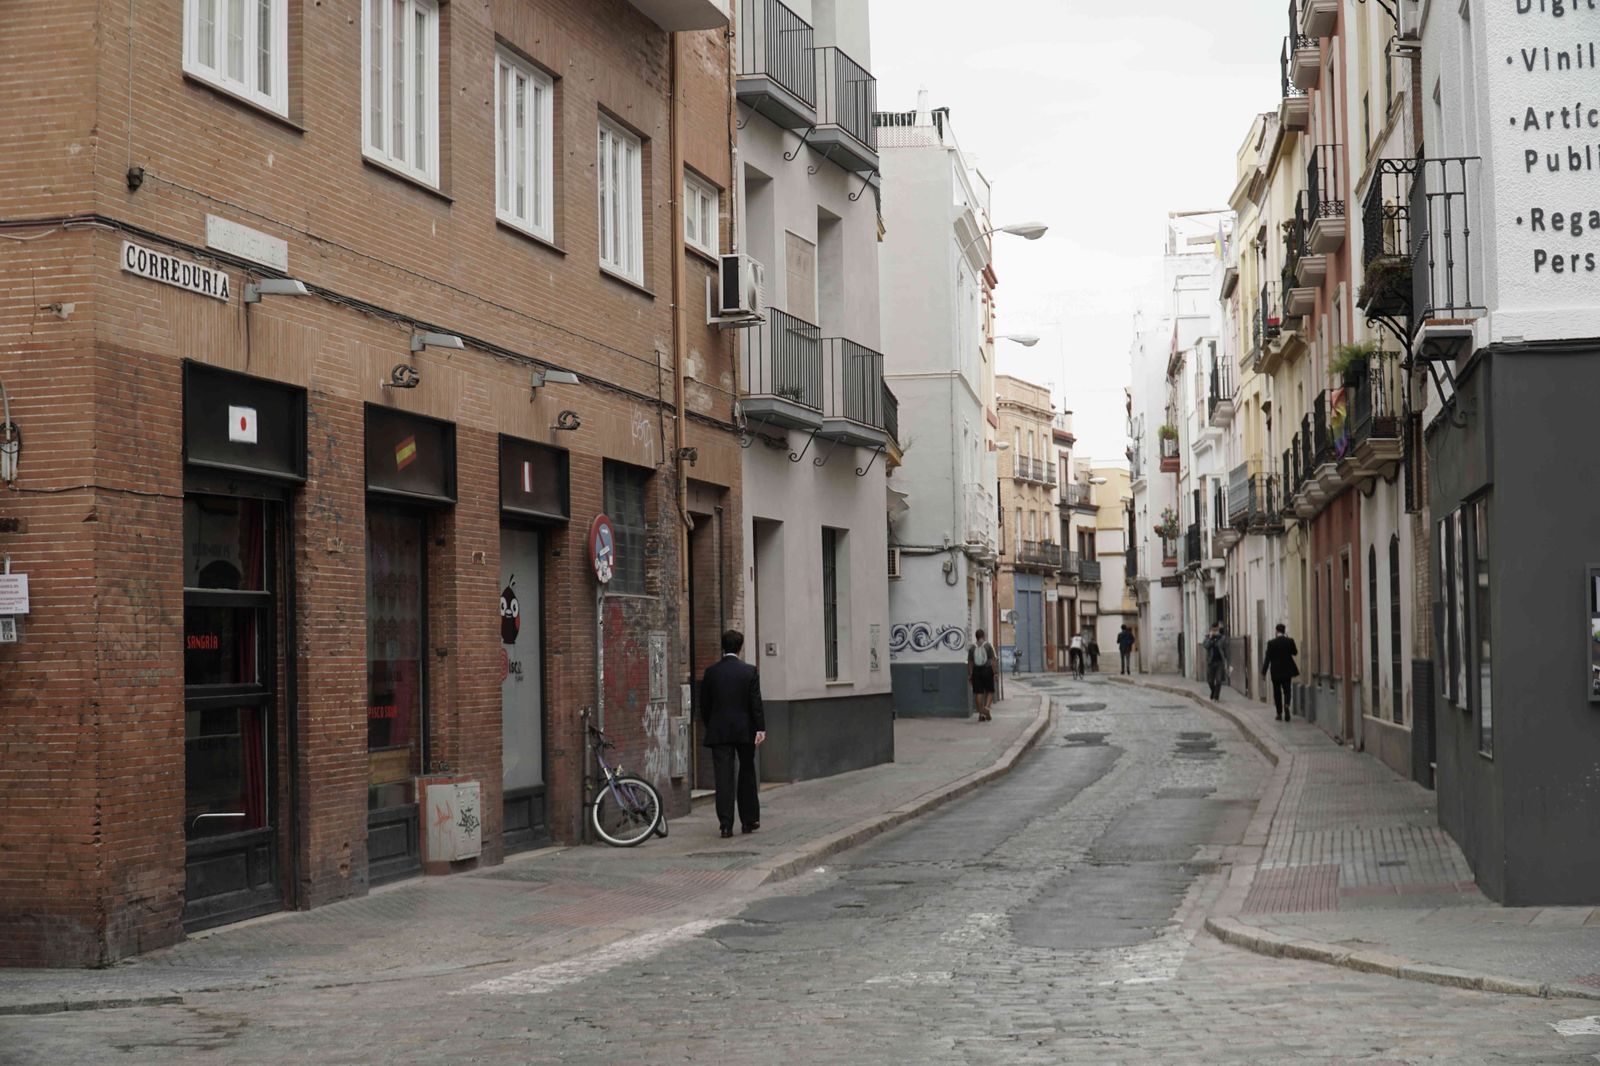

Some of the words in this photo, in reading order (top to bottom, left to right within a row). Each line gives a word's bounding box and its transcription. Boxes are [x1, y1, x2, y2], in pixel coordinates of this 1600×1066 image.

[1521, 42, 1595, 72] Vinil
[1523, 102, 1599, 131] Artíc
[1531, 207, 1600, 237] Rega
[126, 245, 229, 298] CORREDURIA
[1534, 249, 1595, 274] Pers
